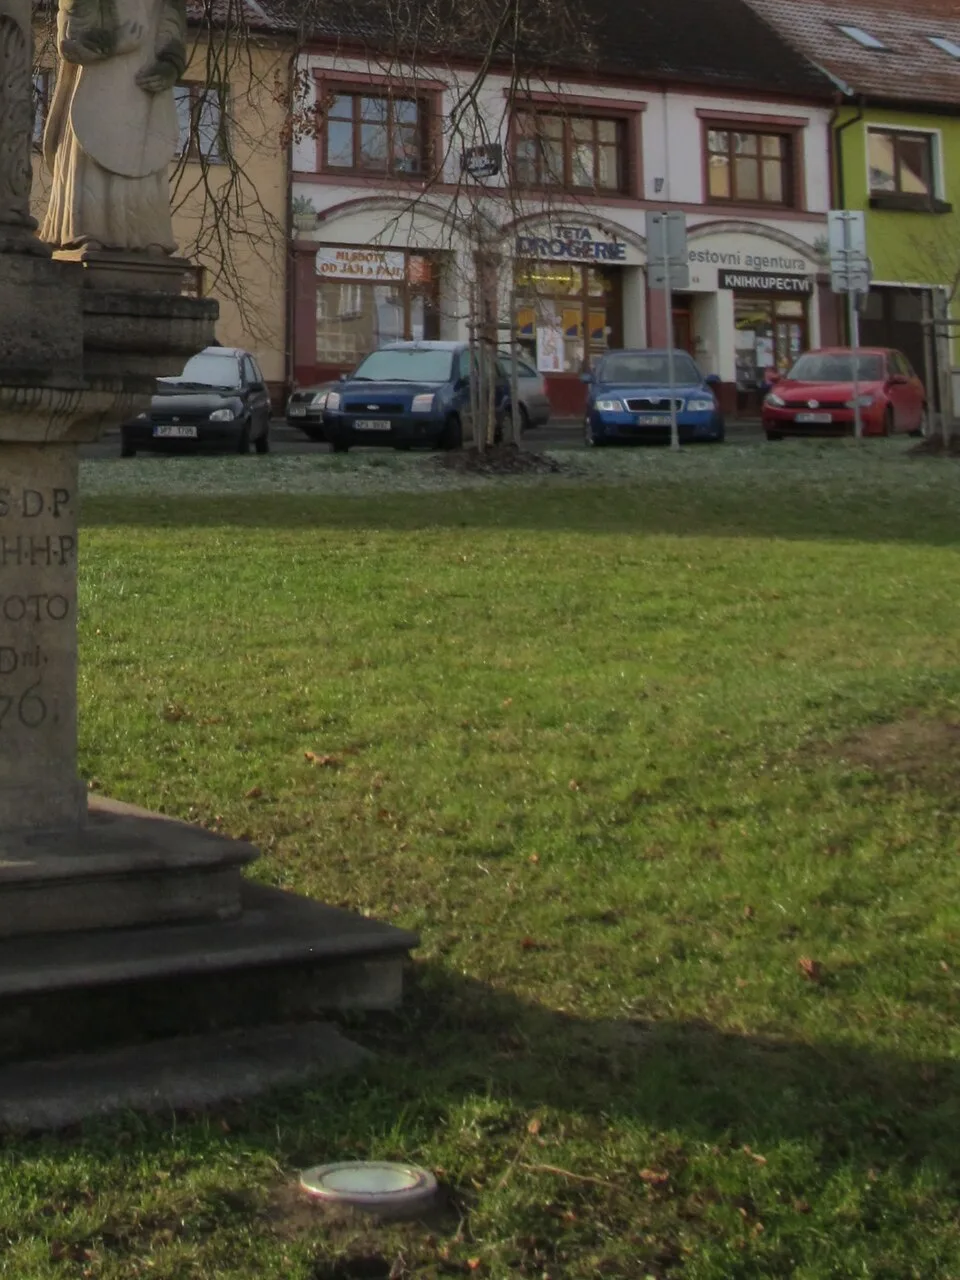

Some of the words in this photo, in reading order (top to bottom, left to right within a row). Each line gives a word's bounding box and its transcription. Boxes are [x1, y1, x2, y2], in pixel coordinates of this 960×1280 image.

[553, 225, 593, 241] TETA
[515, 236, 627, 261] DROGERIE
[745, 254, 807, 272] agentura
